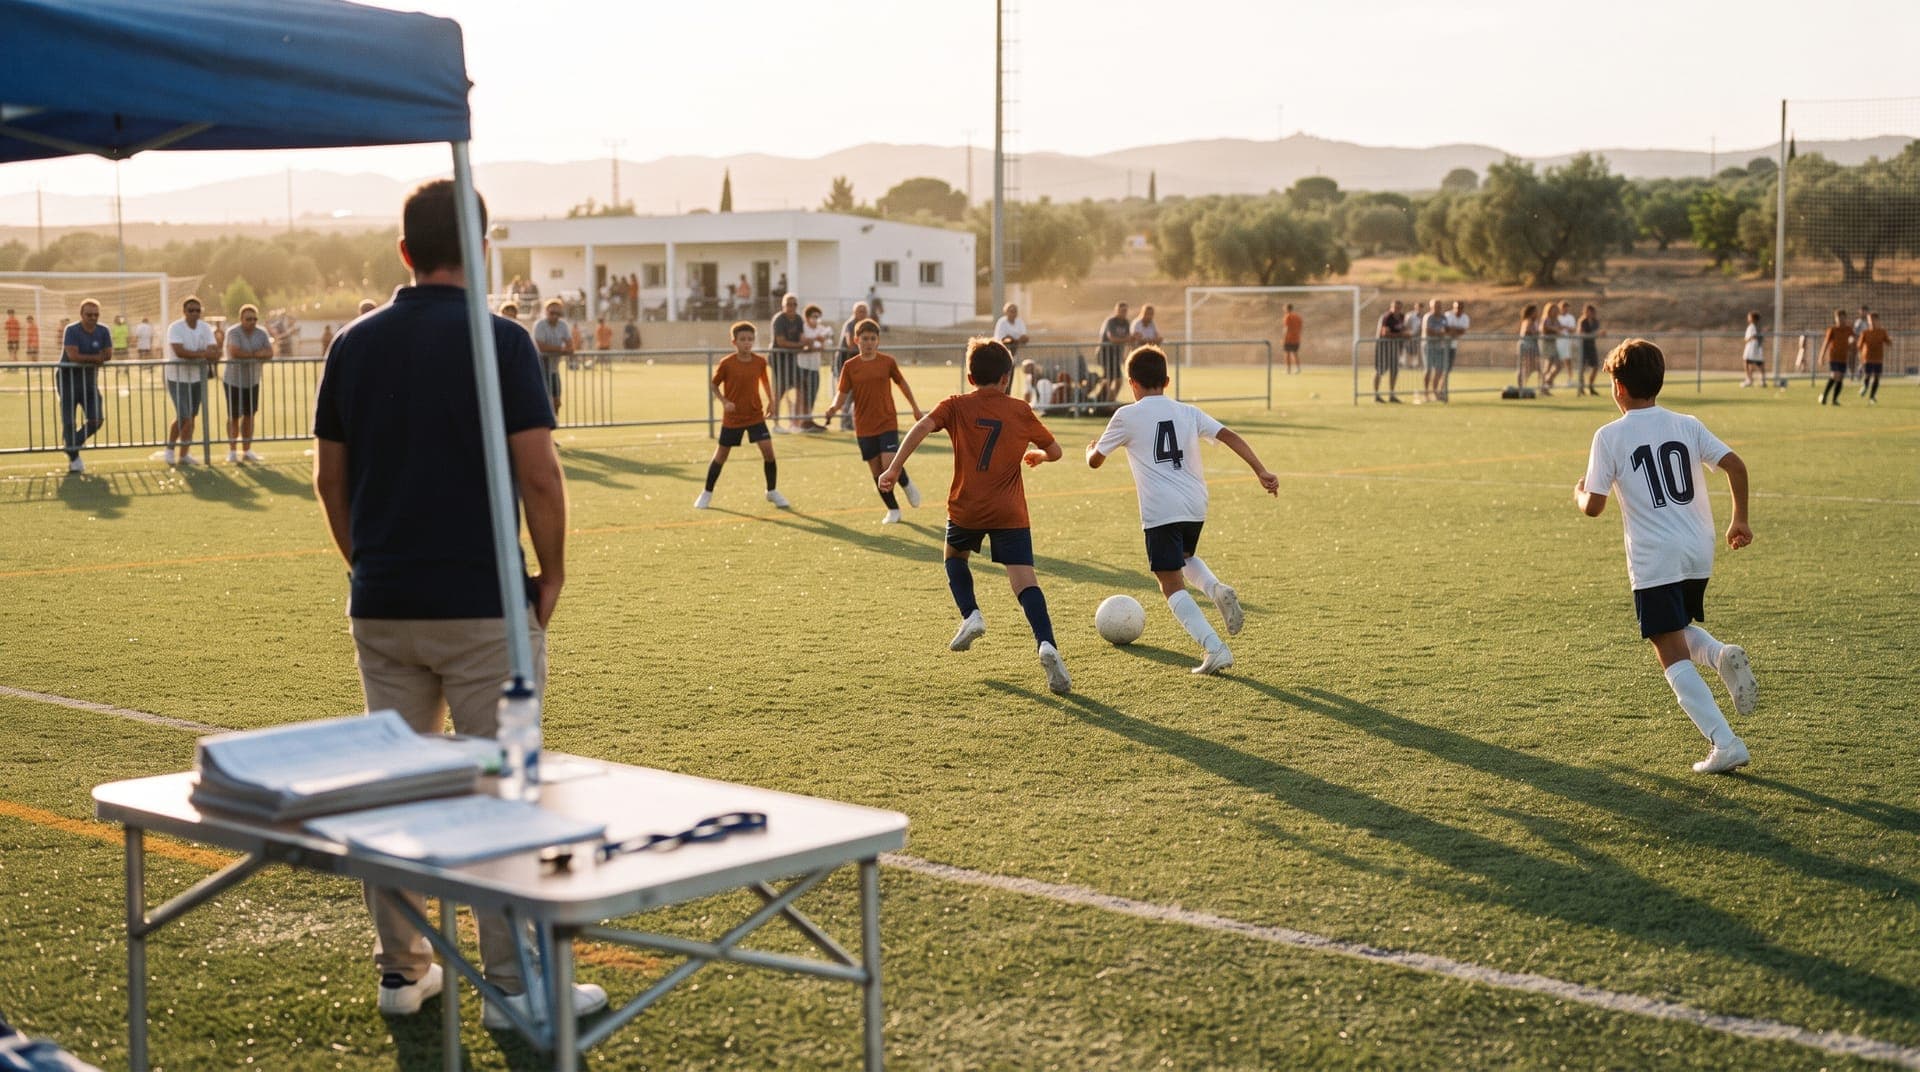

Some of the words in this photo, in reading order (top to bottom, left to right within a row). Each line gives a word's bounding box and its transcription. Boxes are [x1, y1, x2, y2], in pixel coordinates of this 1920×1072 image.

[976, 418, 1002, 472] 7
[1153, 420, 1184, 470] 4
[1630, 441, 1694, 508] 10
